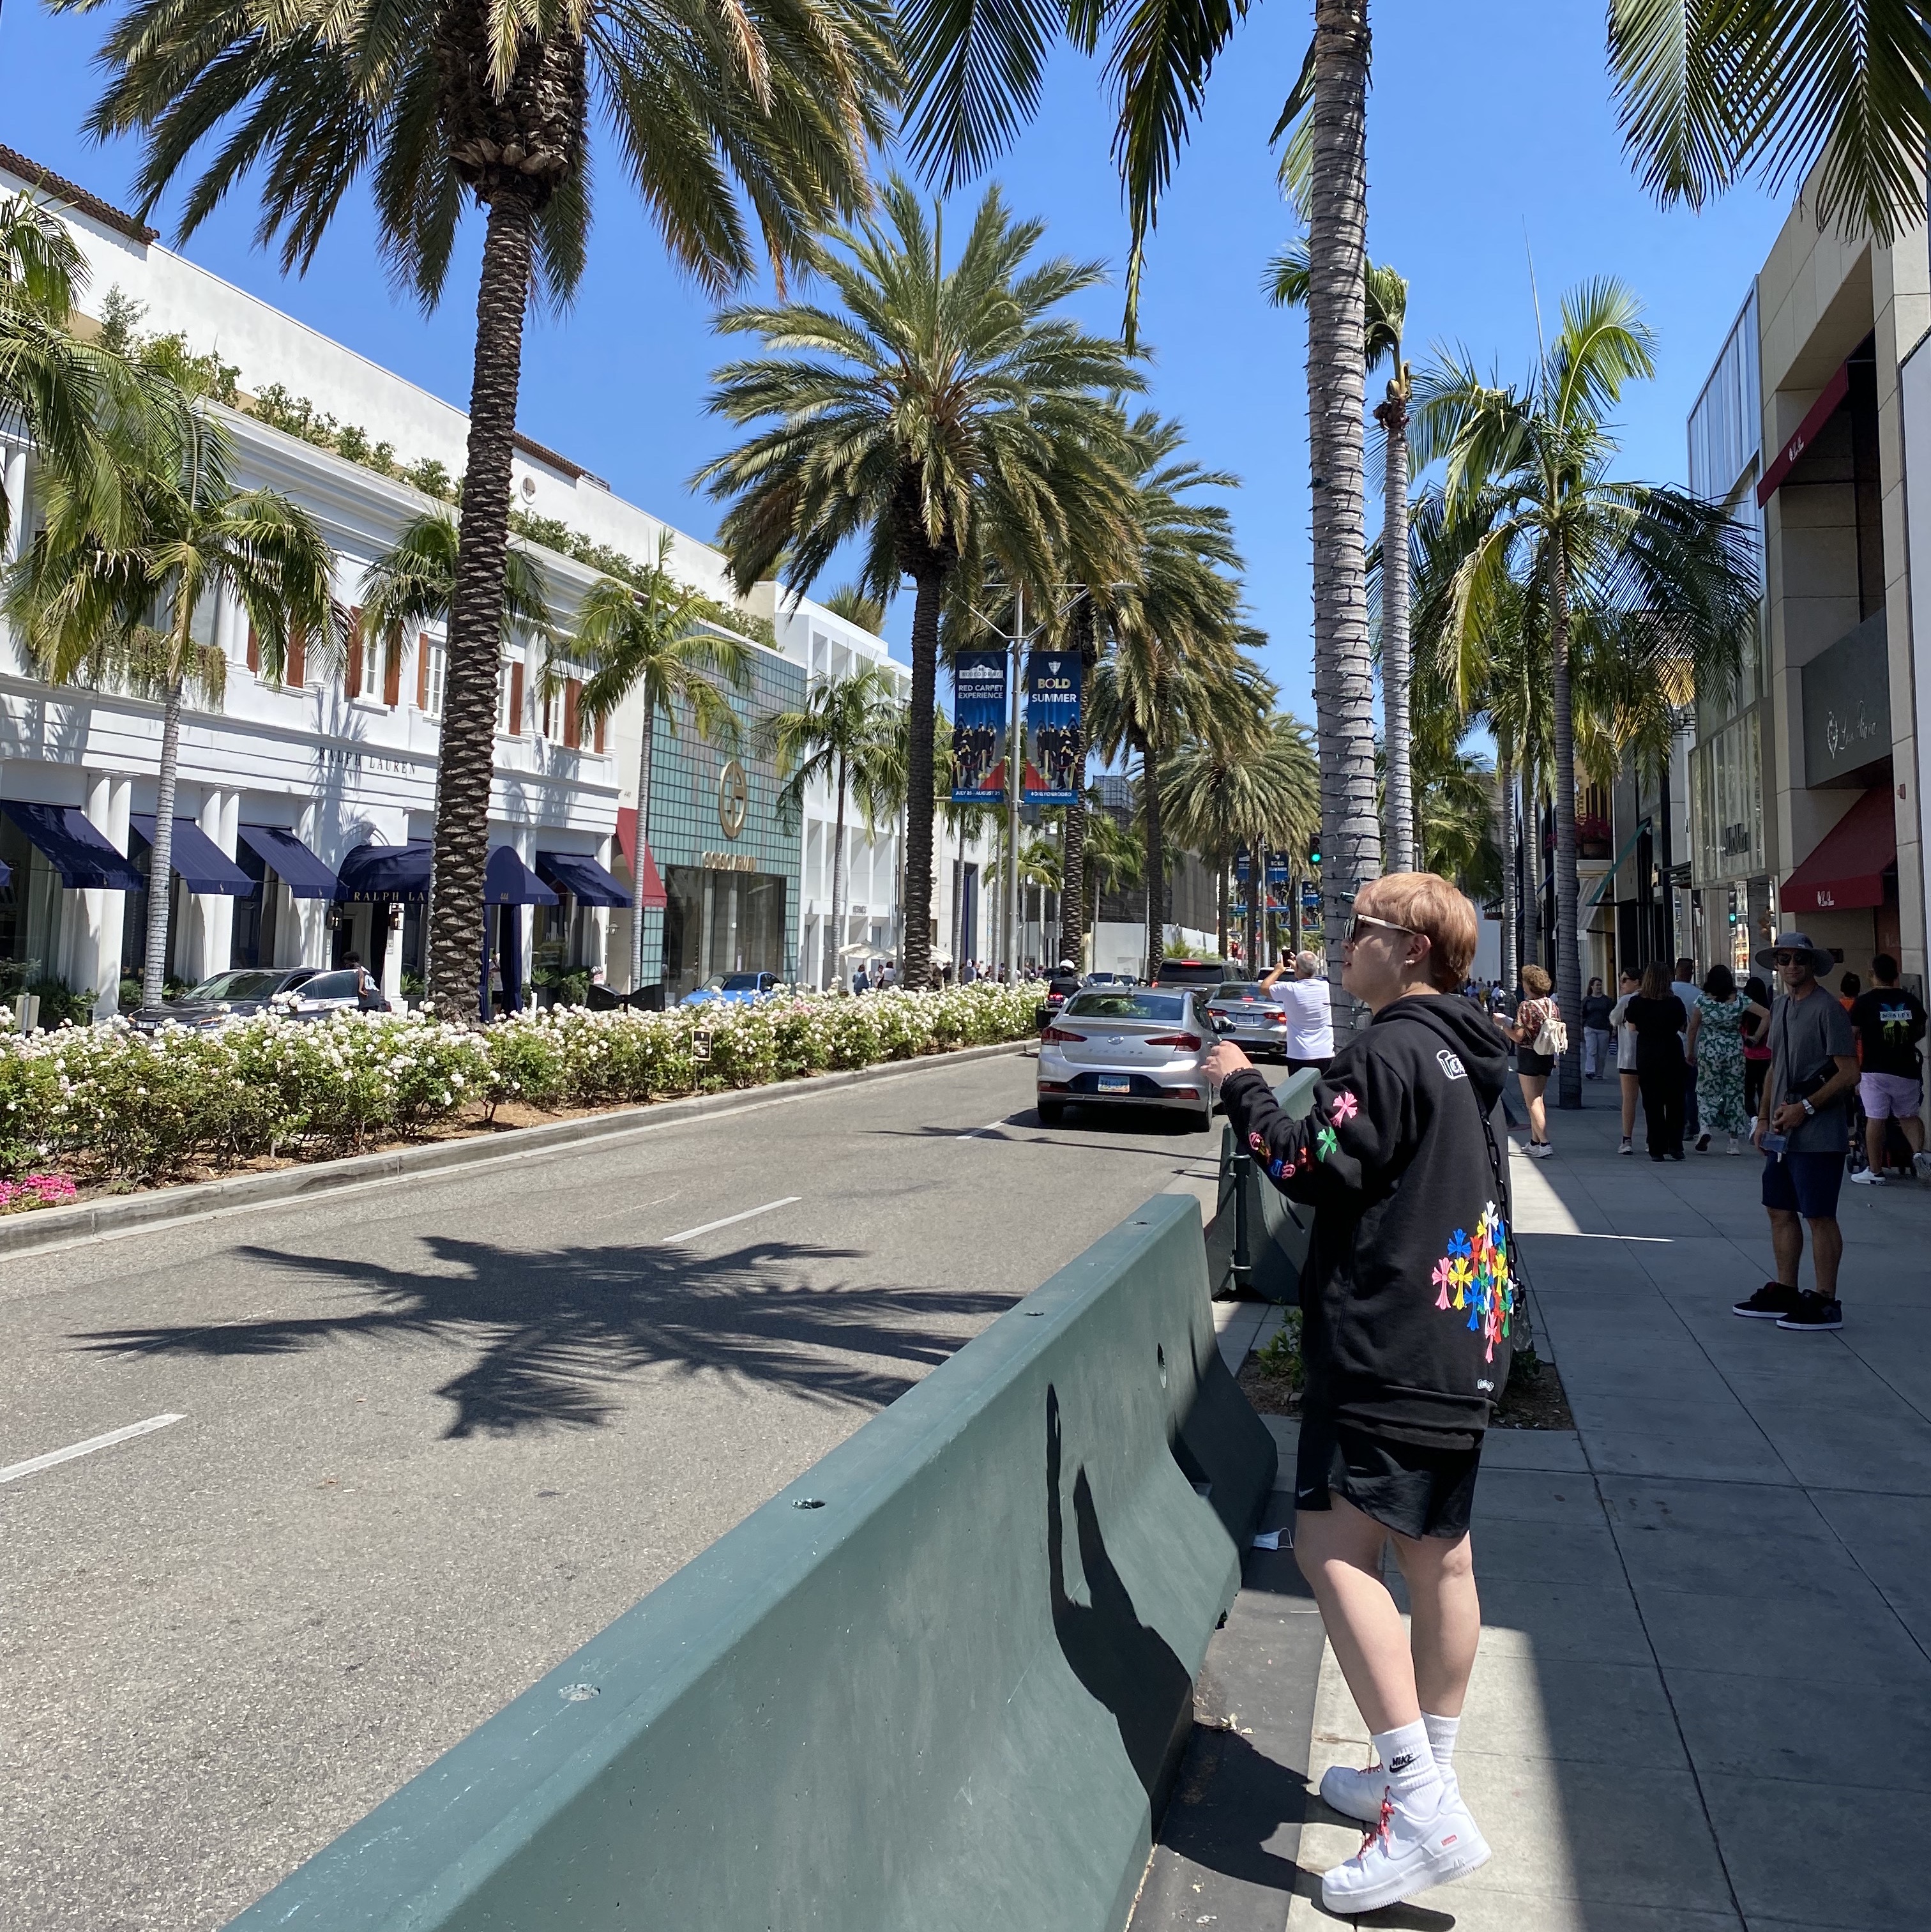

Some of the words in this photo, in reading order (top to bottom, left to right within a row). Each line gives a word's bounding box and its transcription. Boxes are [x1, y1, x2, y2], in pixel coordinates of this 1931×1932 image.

[1038, 678, 1071, 689] BOLD
[1032, 694, 1077, 703] SUMMER
[319, 747, 361, 766] RALPH
[369, 757, 416, 775] LAUREN
[354, 892, 399, 902] RALPH
[1392, 1753, 1413, 1767] NIKE
